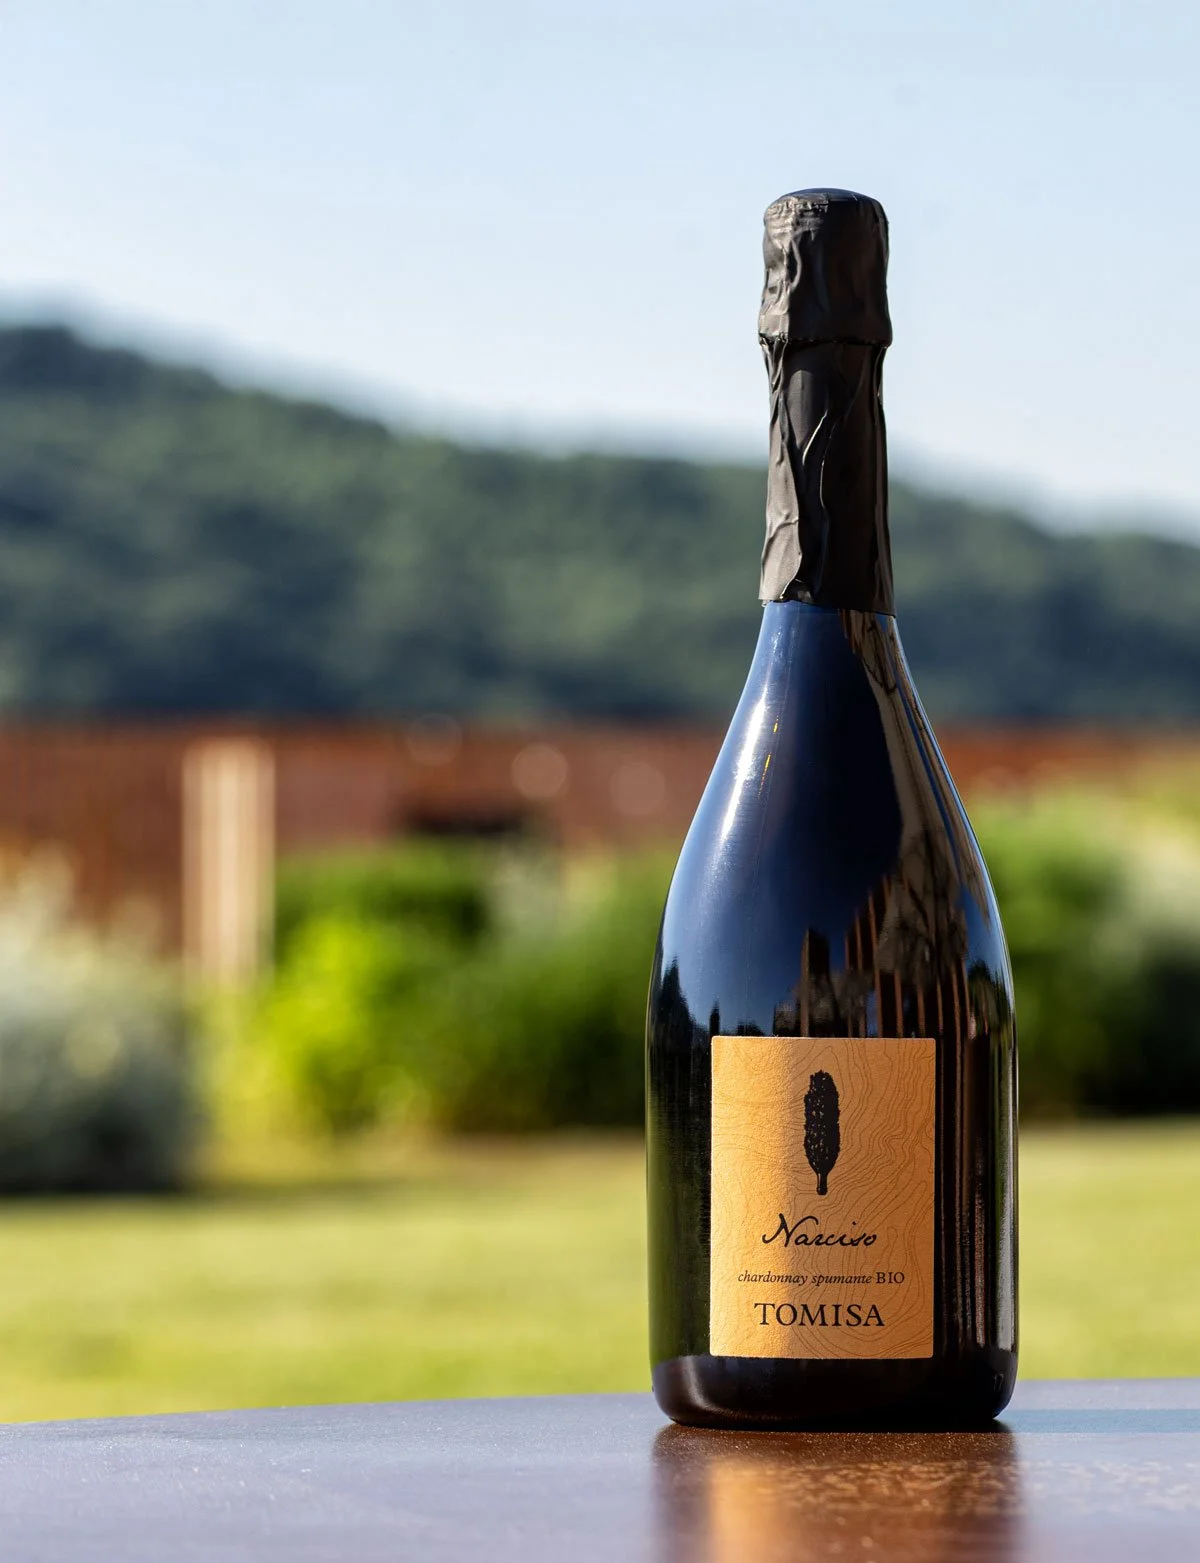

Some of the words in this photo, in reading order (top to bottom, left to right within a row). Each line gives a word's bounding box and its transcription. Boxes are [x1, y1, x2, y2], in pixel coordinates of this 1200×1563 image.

[762, 1213, 877, 1248] Narciso
[737, 1270, 807, 1286] chardonnay
[811, 1272, 872, 1287] spumante
[876, 1272, 905, 1284] BIO
[754, 1303, 885, 1327] TOMISA
